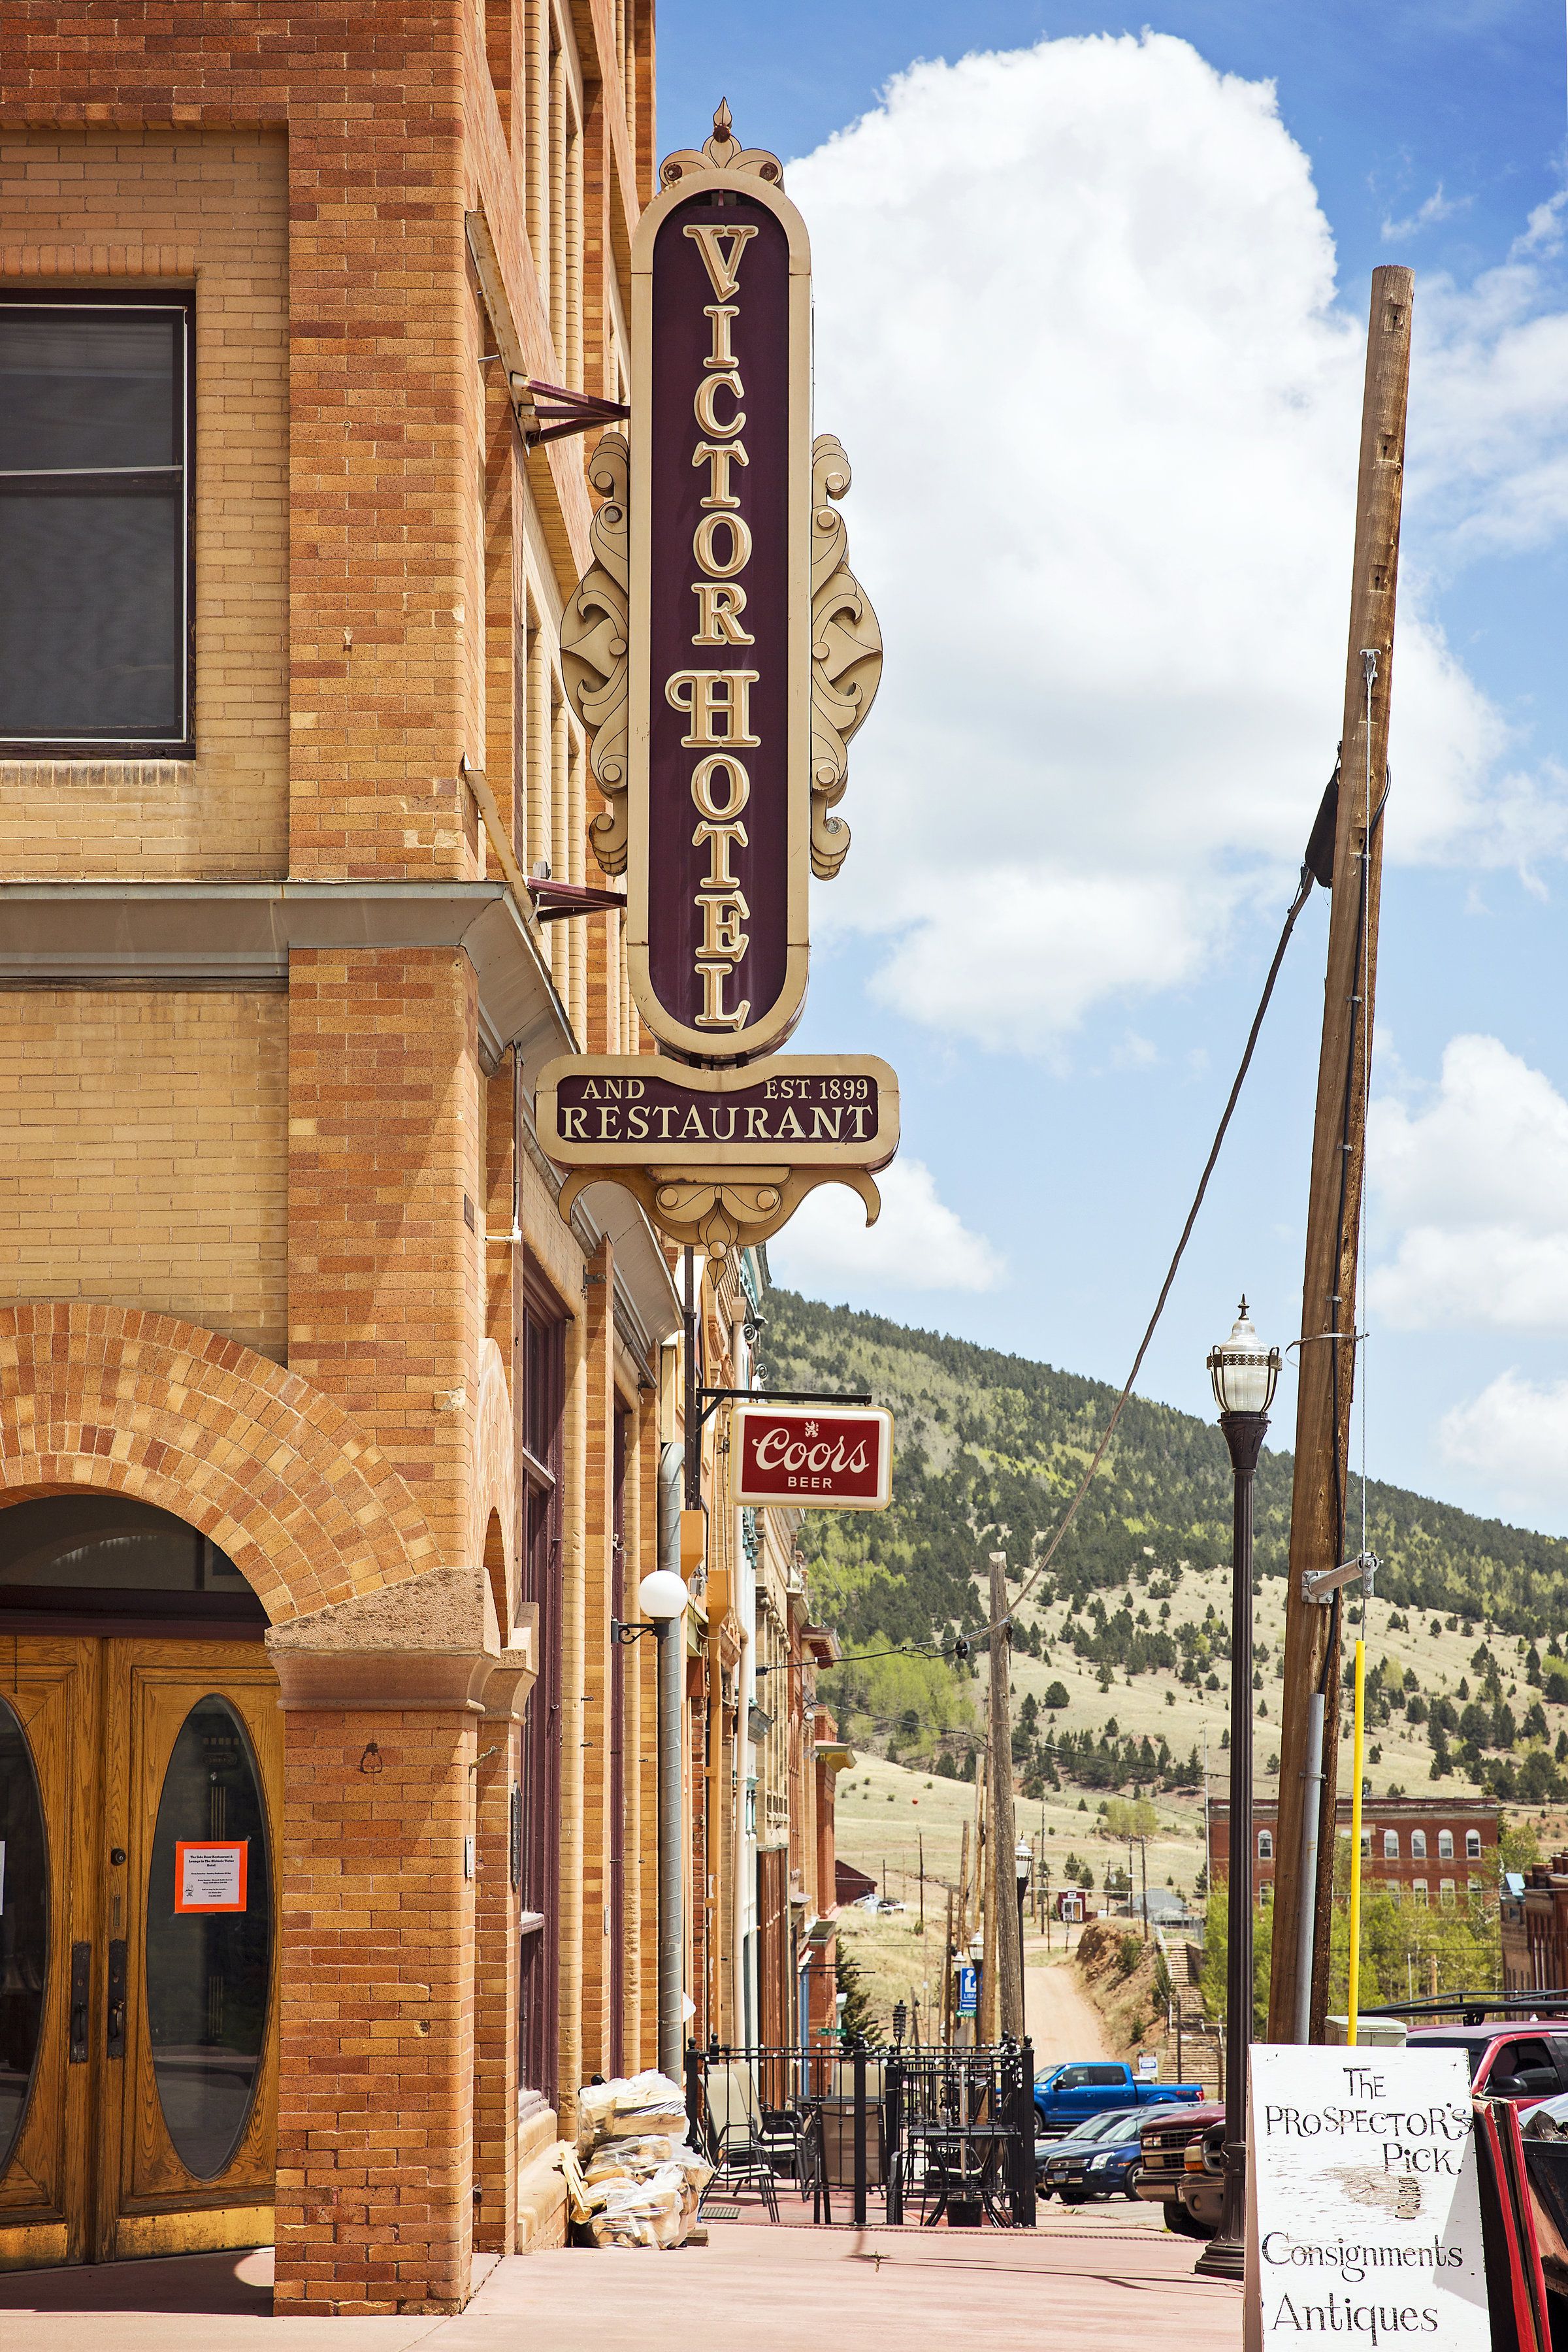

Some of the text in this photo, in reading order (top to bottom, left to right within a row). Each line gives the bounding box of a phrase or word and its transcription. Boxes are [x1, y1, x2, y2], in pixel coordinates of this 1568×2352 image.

[683, 224, 759, 645] VICTOR
[665, 670, 762, 1031] HOTEL
[581, 1079, 645, 1100] AND
[764, 1078, 869, 1100] EST. 1899
[561, 1104, 873, 1140] RESTAURANT
[752, 1428, 870, 1473] Coors
[788, 1477, 832, 1488] BEER
[1262, 2232, 1463, 2282] Consignments
[1271, 2293, 1439, 2346] Antiques
